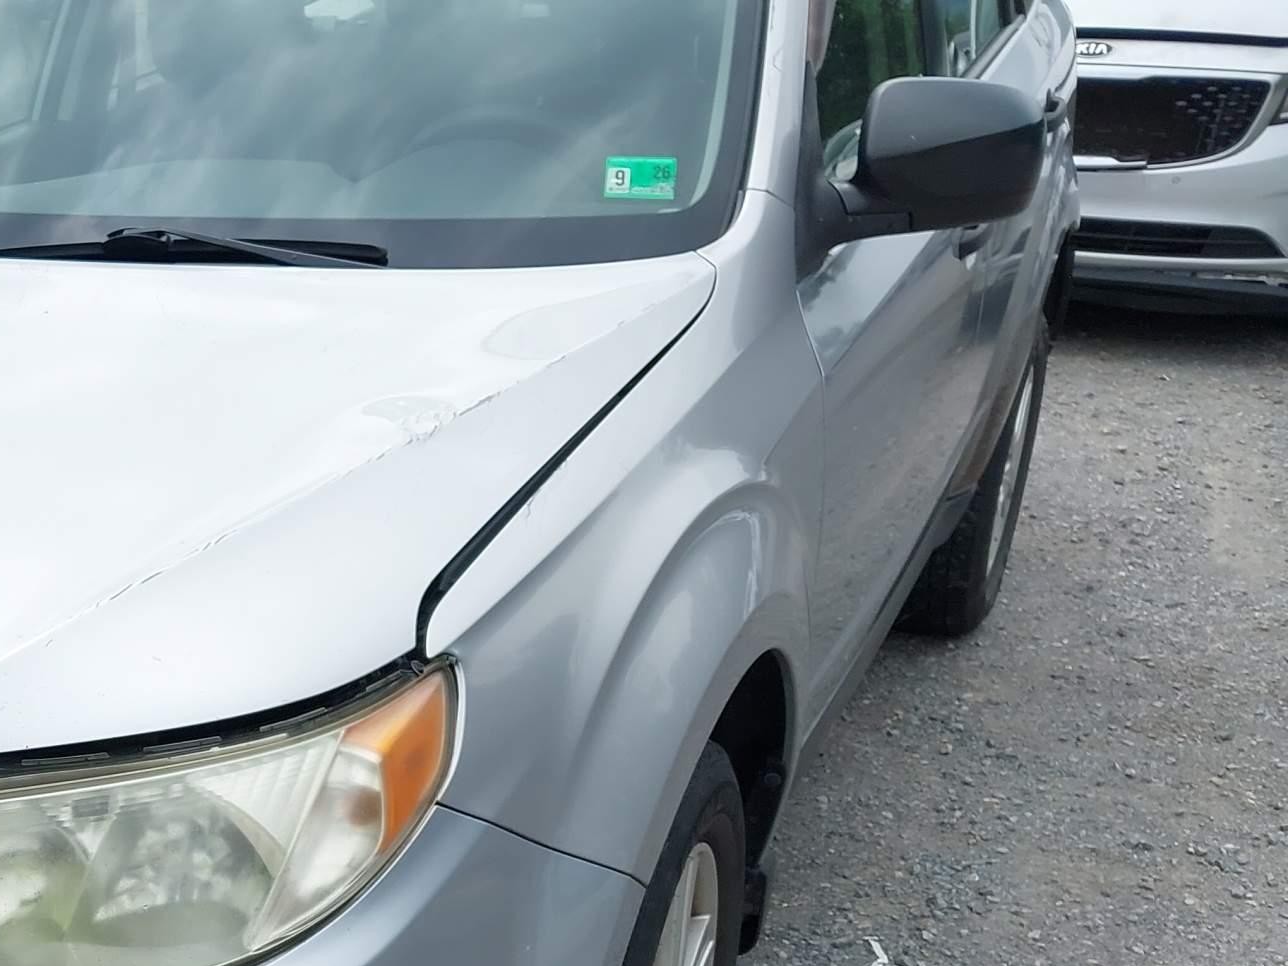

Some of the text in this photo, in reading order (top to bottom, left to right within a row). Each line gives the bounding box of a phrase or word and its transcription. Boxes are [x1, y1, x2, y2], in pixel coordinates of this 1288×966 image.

[1076, 43, 1108, 55] KIA
[615, 170, 625, 186] 9
[654, 166, 671, 180] 26
